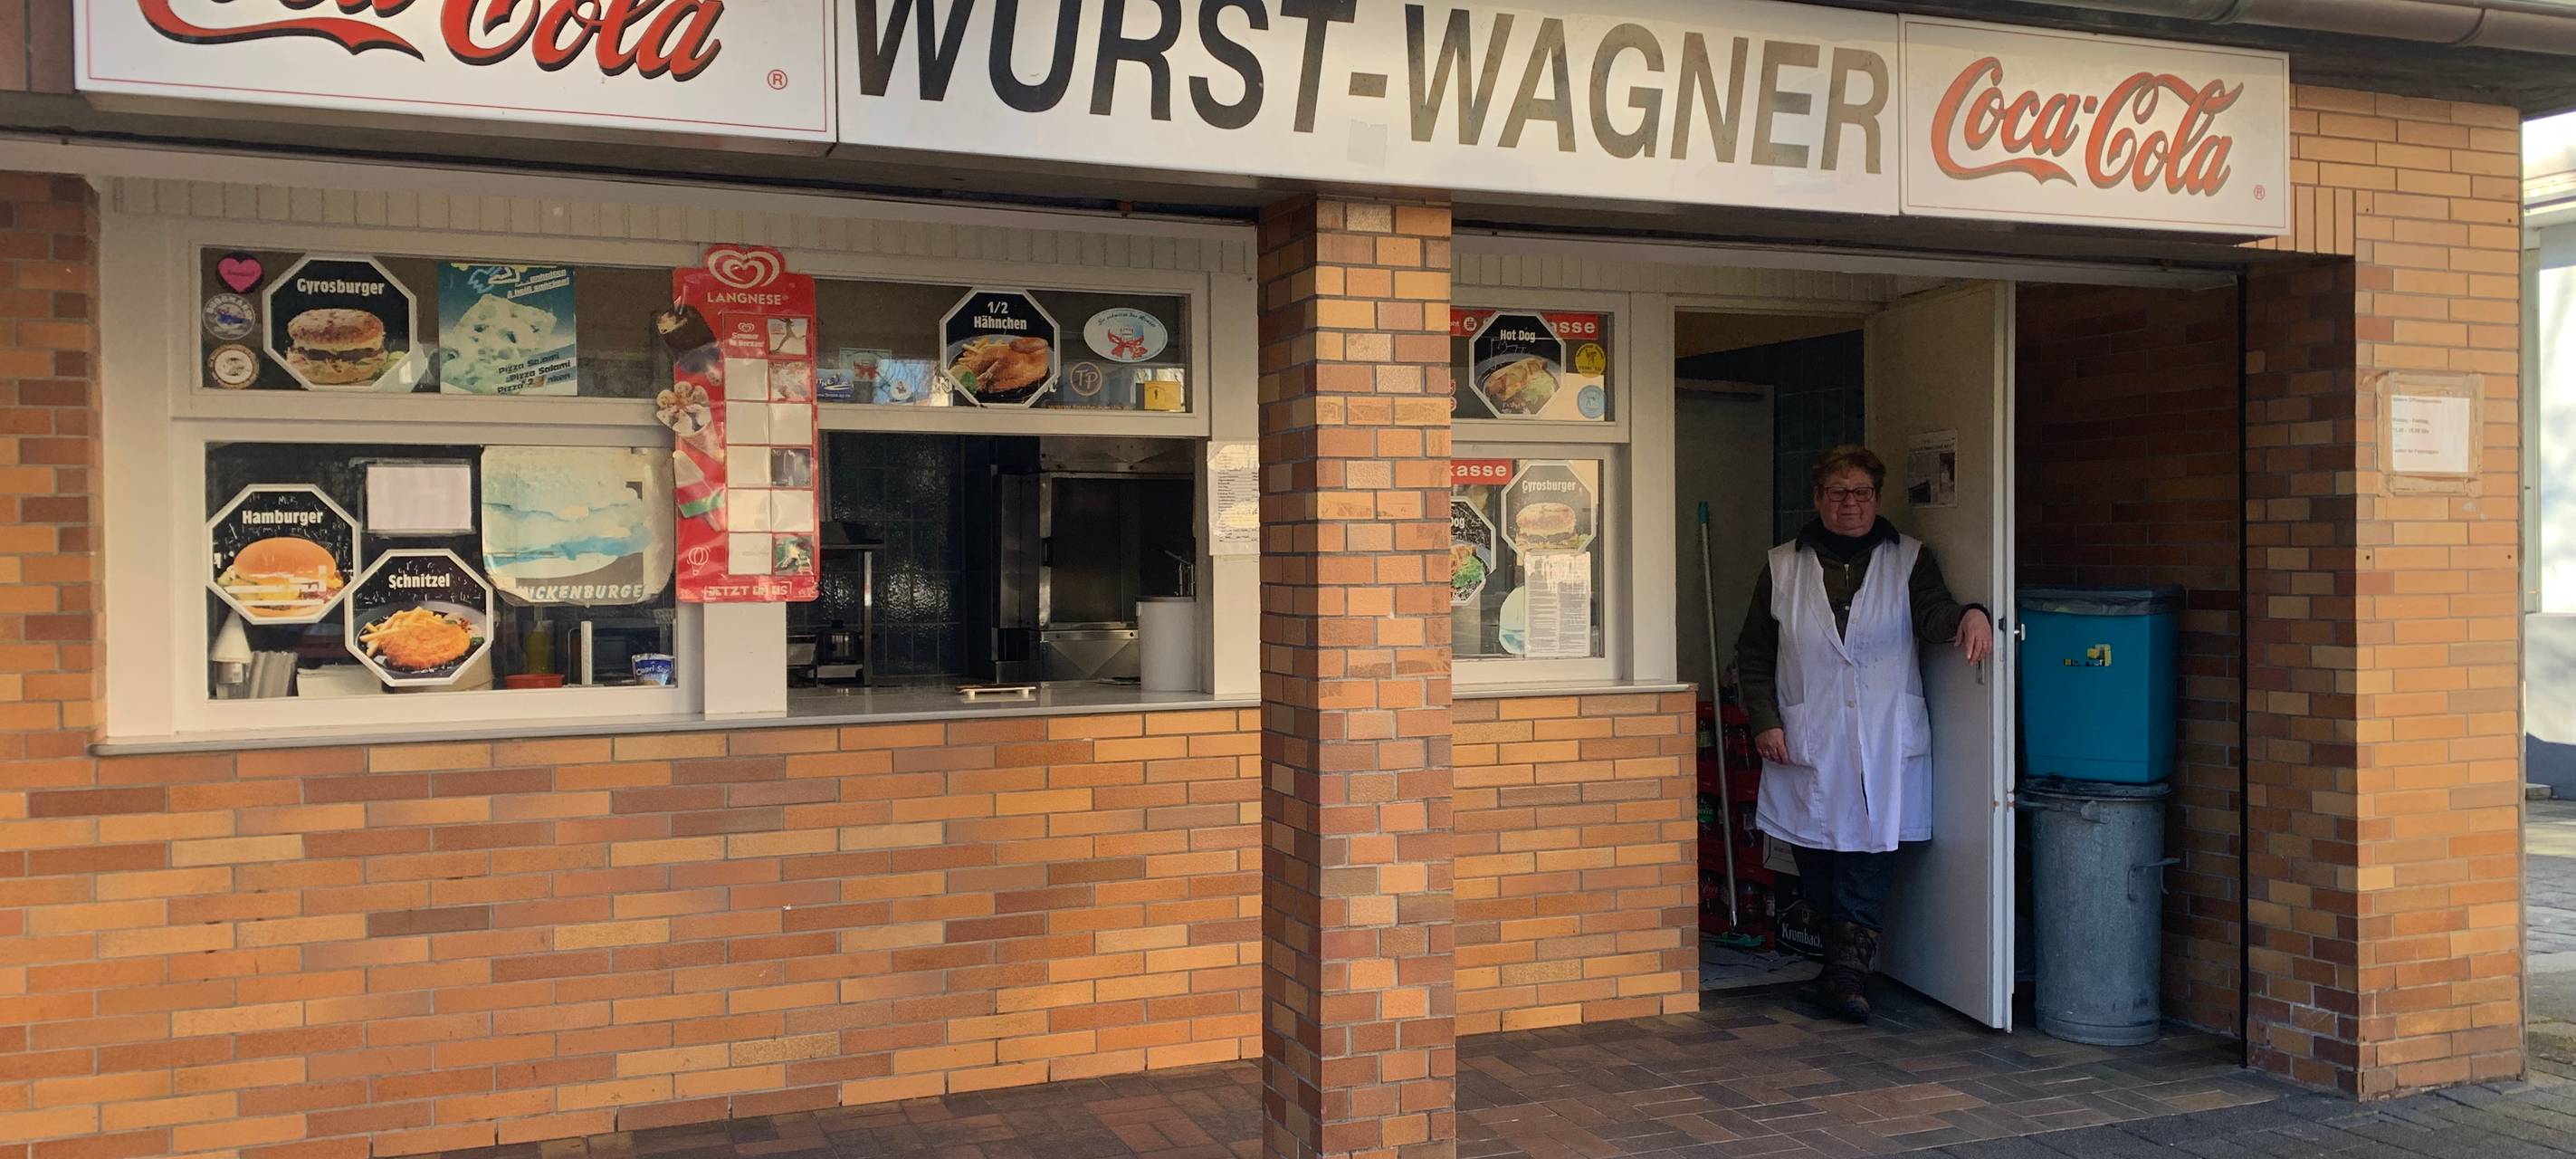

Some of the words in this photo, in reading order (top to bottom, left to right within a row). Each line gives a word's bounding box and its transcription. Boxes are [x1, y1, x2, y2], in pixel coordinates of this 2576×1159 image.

[297, 278, 385, 296] Gyrosburger
[708, 292, 781, 305] LANGNESE
[987, 302, 1008, 314] 1/2
[974, 315, 1027, 330] Hähnchen
[1500, 330, 1516, 340] Hot
[1519, 330, 1536, 342] Dog
[1449, 463, 1508, 477] kasse
[1522, 480, 1577, 493] Gyrosburger
[242, 509, 323, 525] Hamburger
[388, 572, 451, 589] Schnitzel
[1781, 923, 1824, 949] Krombac
